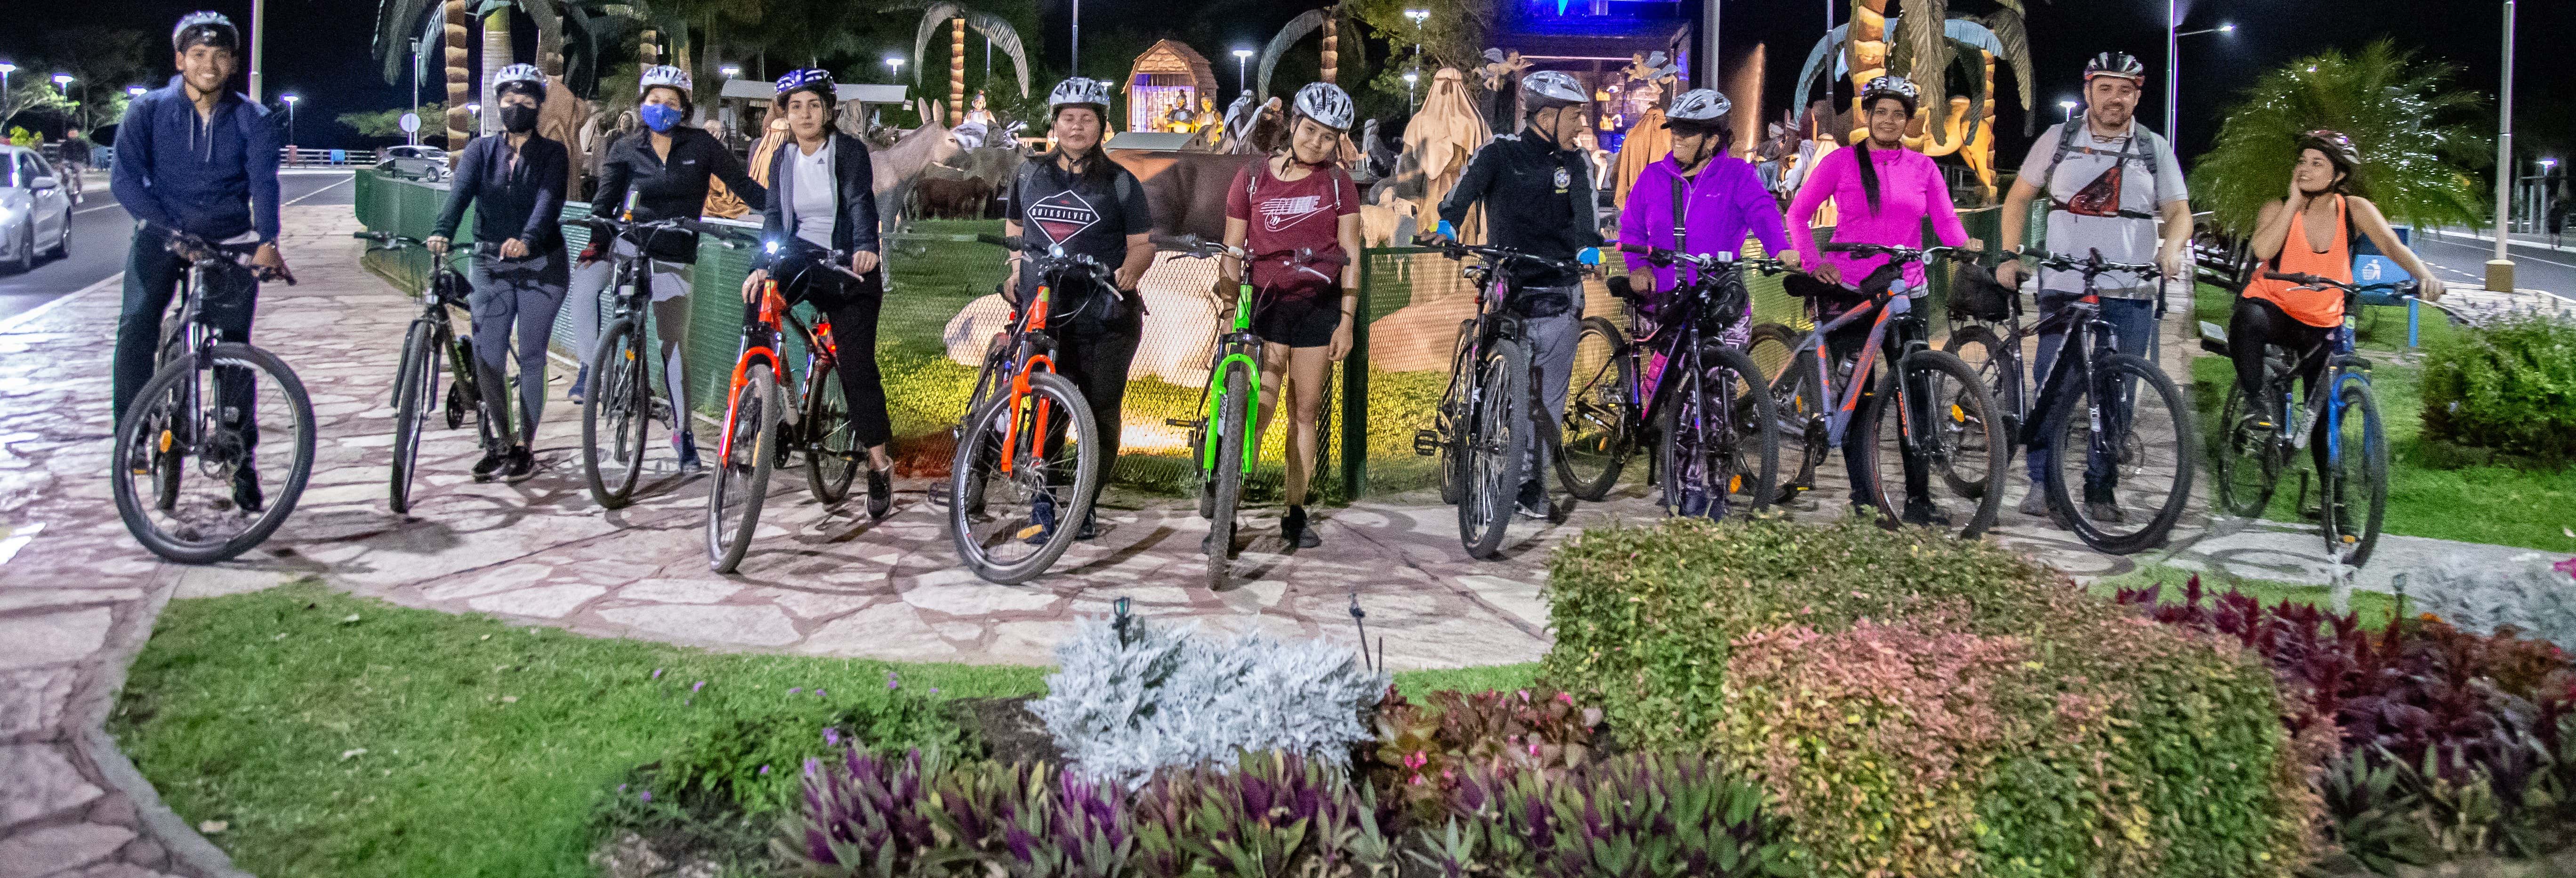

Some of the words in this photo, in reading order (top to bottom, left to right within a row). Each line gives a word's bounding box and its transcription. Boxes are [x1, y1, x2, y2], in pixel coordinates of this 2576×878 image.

[1032, 209, 1090, 221] QUIKSILVER
[1265, 195, 1321, 215] NIKE
[1219, 395, 1227, 420] RIDER
